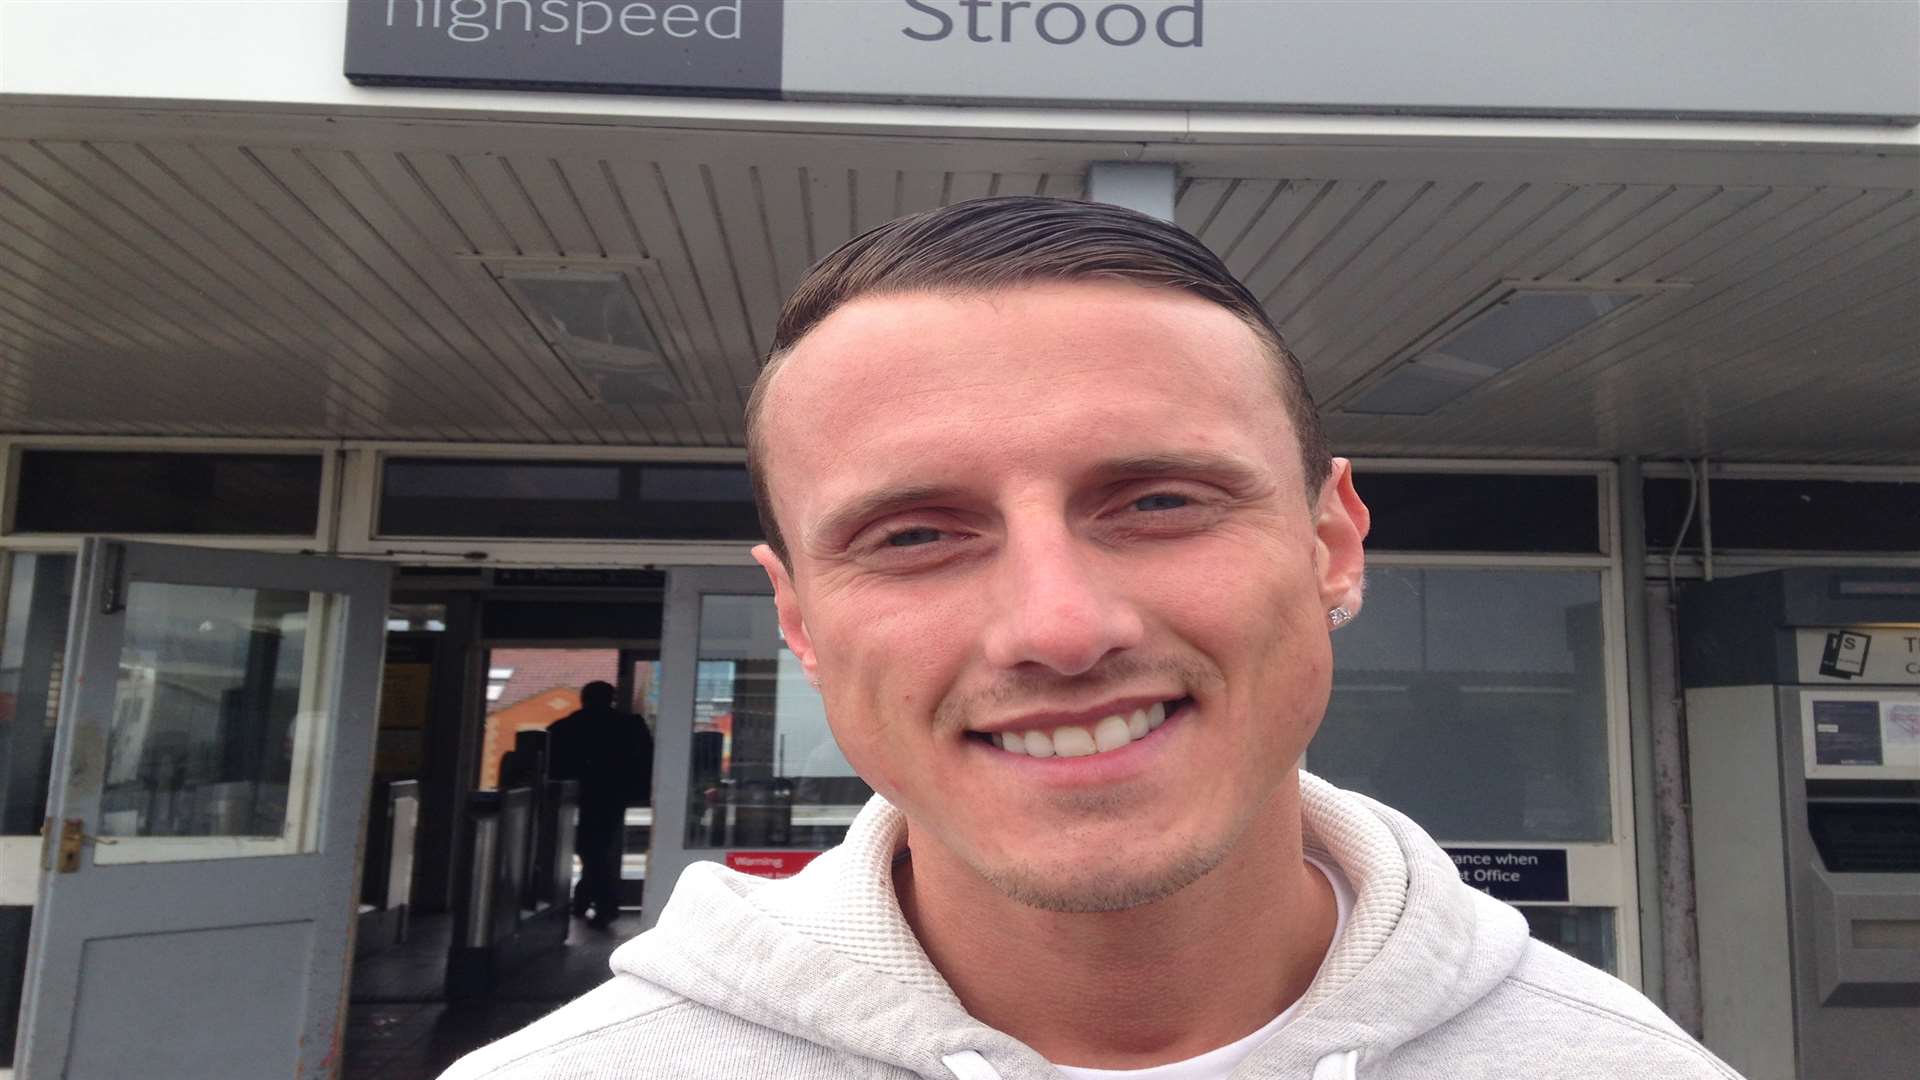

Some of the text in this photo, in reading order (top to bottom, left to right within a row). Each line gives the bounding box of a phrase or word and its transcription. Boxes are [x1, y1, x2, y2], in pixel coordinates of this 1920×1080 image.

[902, 0, 1203, 47] Strood
[735, 857, 783, 868] Warning
[1495, 853, 1539, 866] when
[1474, 869, 1520, 882] Office
